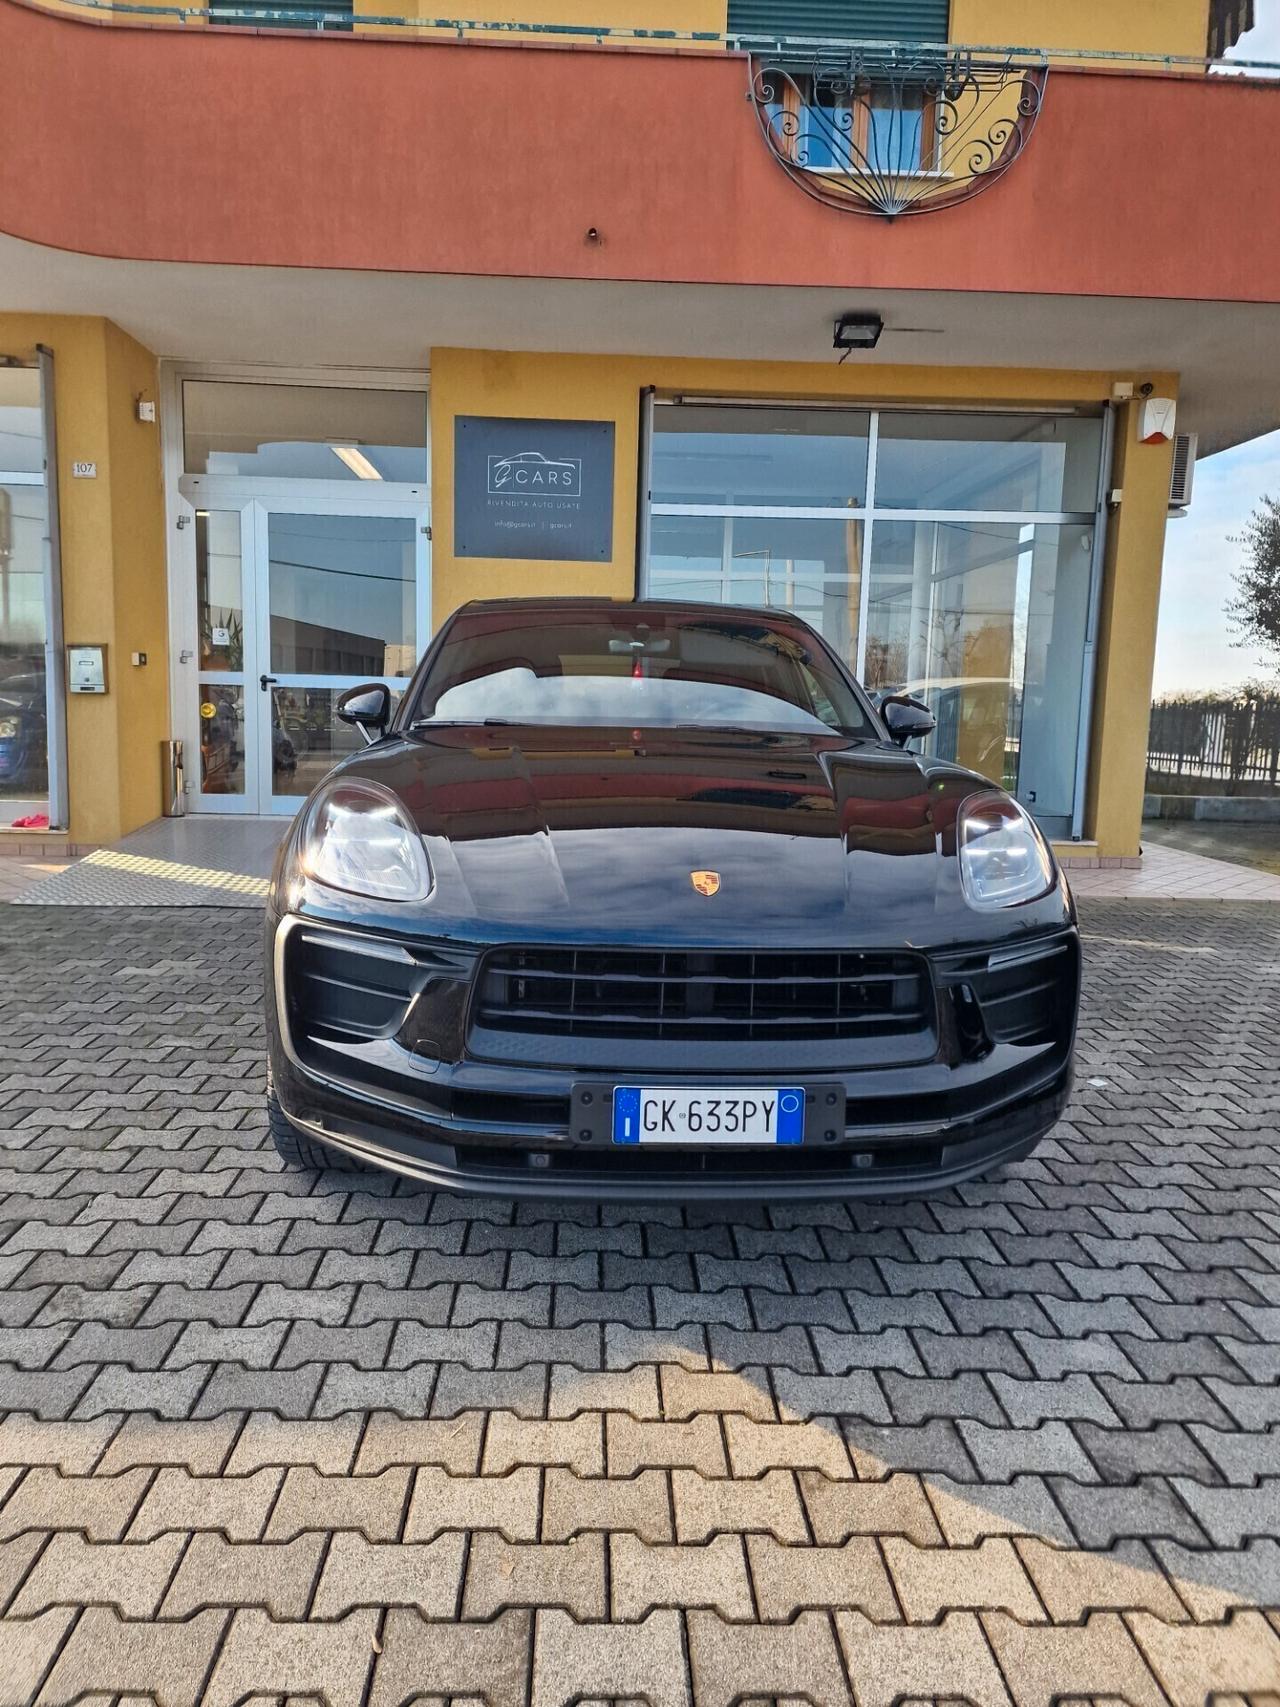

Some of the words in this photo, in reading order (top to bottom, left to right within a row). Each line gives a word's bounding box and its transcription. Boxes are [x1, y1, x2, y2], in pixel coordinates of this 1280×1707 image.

[76, 463, 93, 473] 107
[515, 469, 572, 485] CARS
[487, 499, 529, 507] RIVENDITA
[532, 501, 554, 509] AUTO
